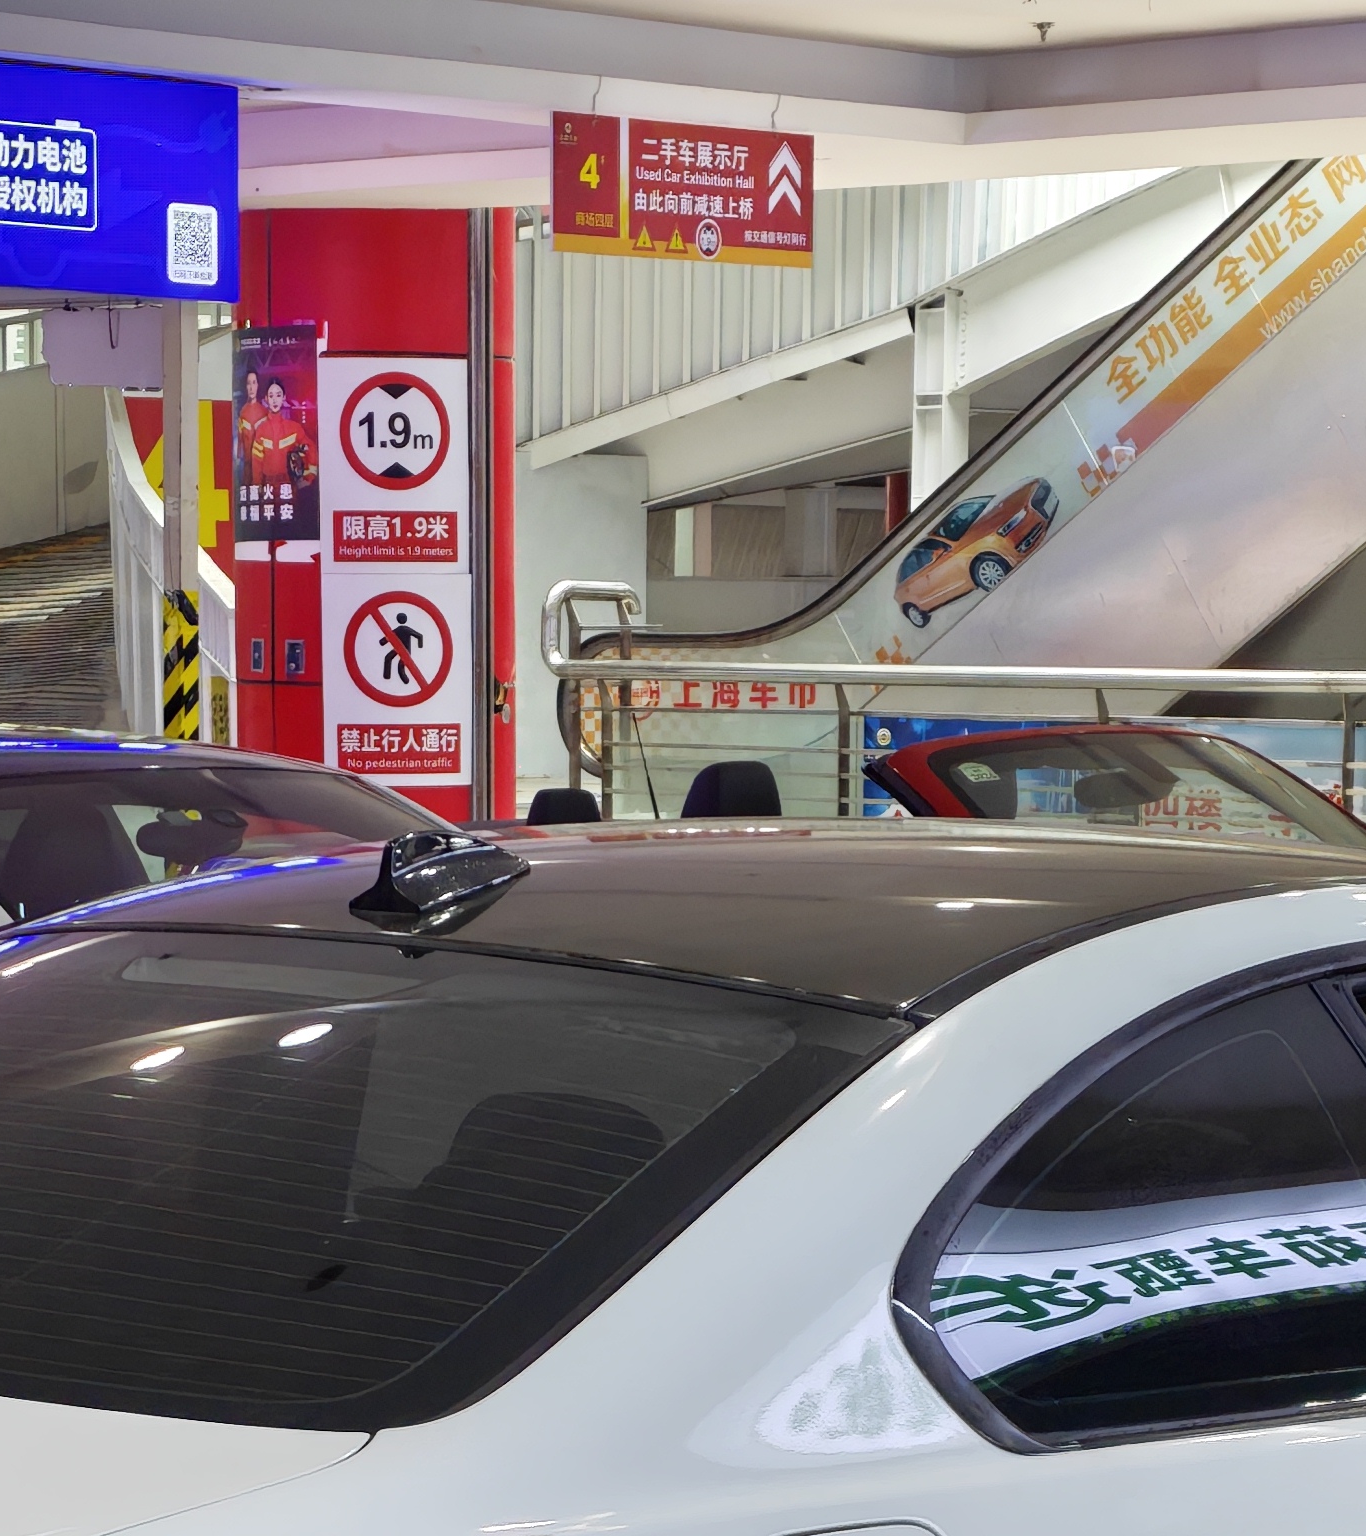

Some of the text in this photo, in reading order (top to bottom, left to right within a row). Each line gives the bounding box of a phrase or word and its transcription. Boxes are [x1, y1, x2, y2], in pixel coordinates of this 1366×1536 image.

[641, 138, 749, 172] 二手车展示厅
[636, 166, 754, 189] Used Car Exhibition Hall
[634, 188, 754, 221] 由此向前减速上桥
[1107, 290, 1214, 404] 全功能
[1213, 187, 1325, 307] 全业态
[358, 411, 434, 451] 1.9m
[342, 514, 450, 540] 限高1.9米
[339, 545, 454, 559] Height limit is 1.9 meters
[673, 681, 816, 709] 上海车市
[340, 728, 458, 754] 禁止行人通行
[347, 757, 453, 771] No pedestrian traffic
